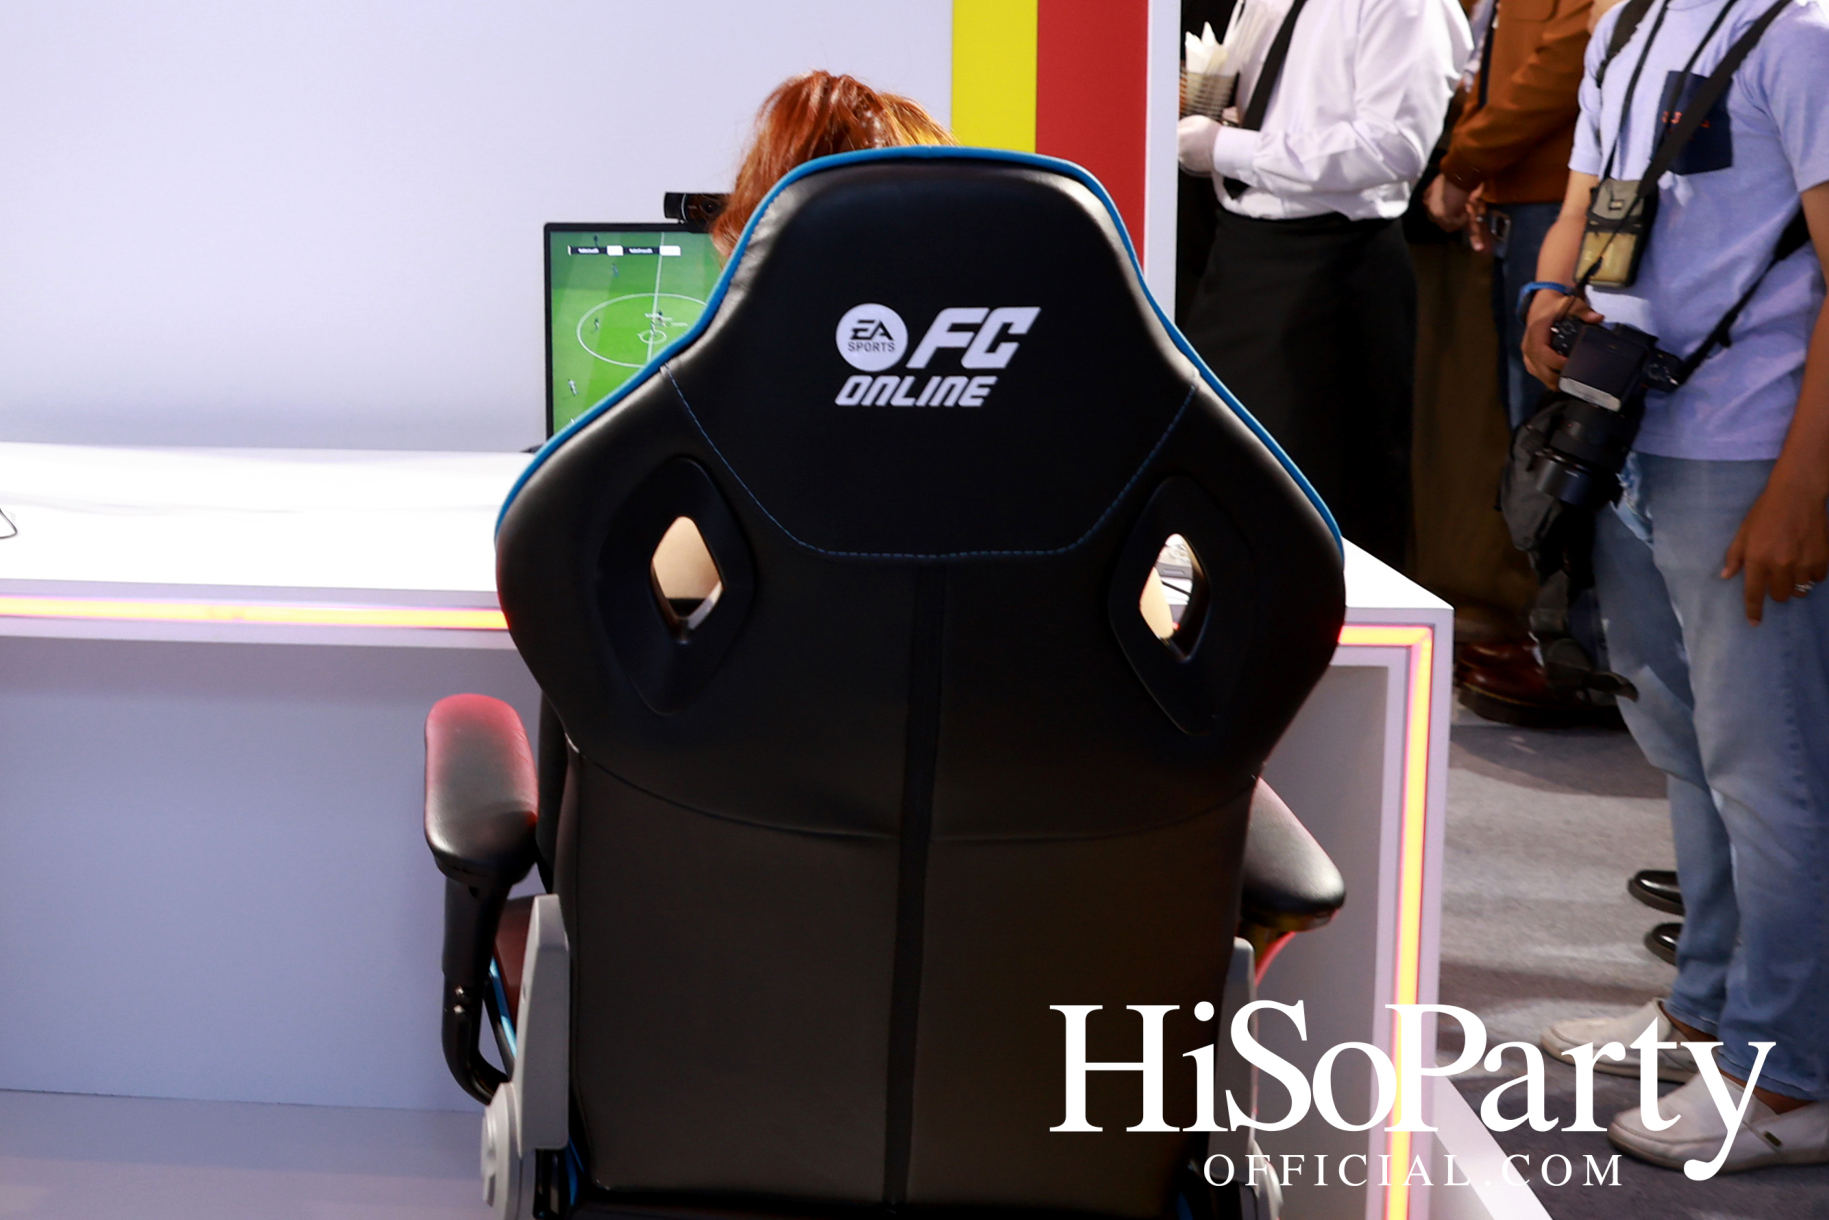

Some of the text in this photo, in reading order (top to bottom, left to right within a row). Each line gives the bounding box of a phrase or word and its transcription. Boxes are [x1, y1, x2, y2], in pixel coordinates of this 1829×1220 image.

[850, 320, 895, 341] EA
[905, 306, 1042, 369] FC
[847, 341, 896, 353] SPORTS
[834, 374, 999, 407] ONLINE
